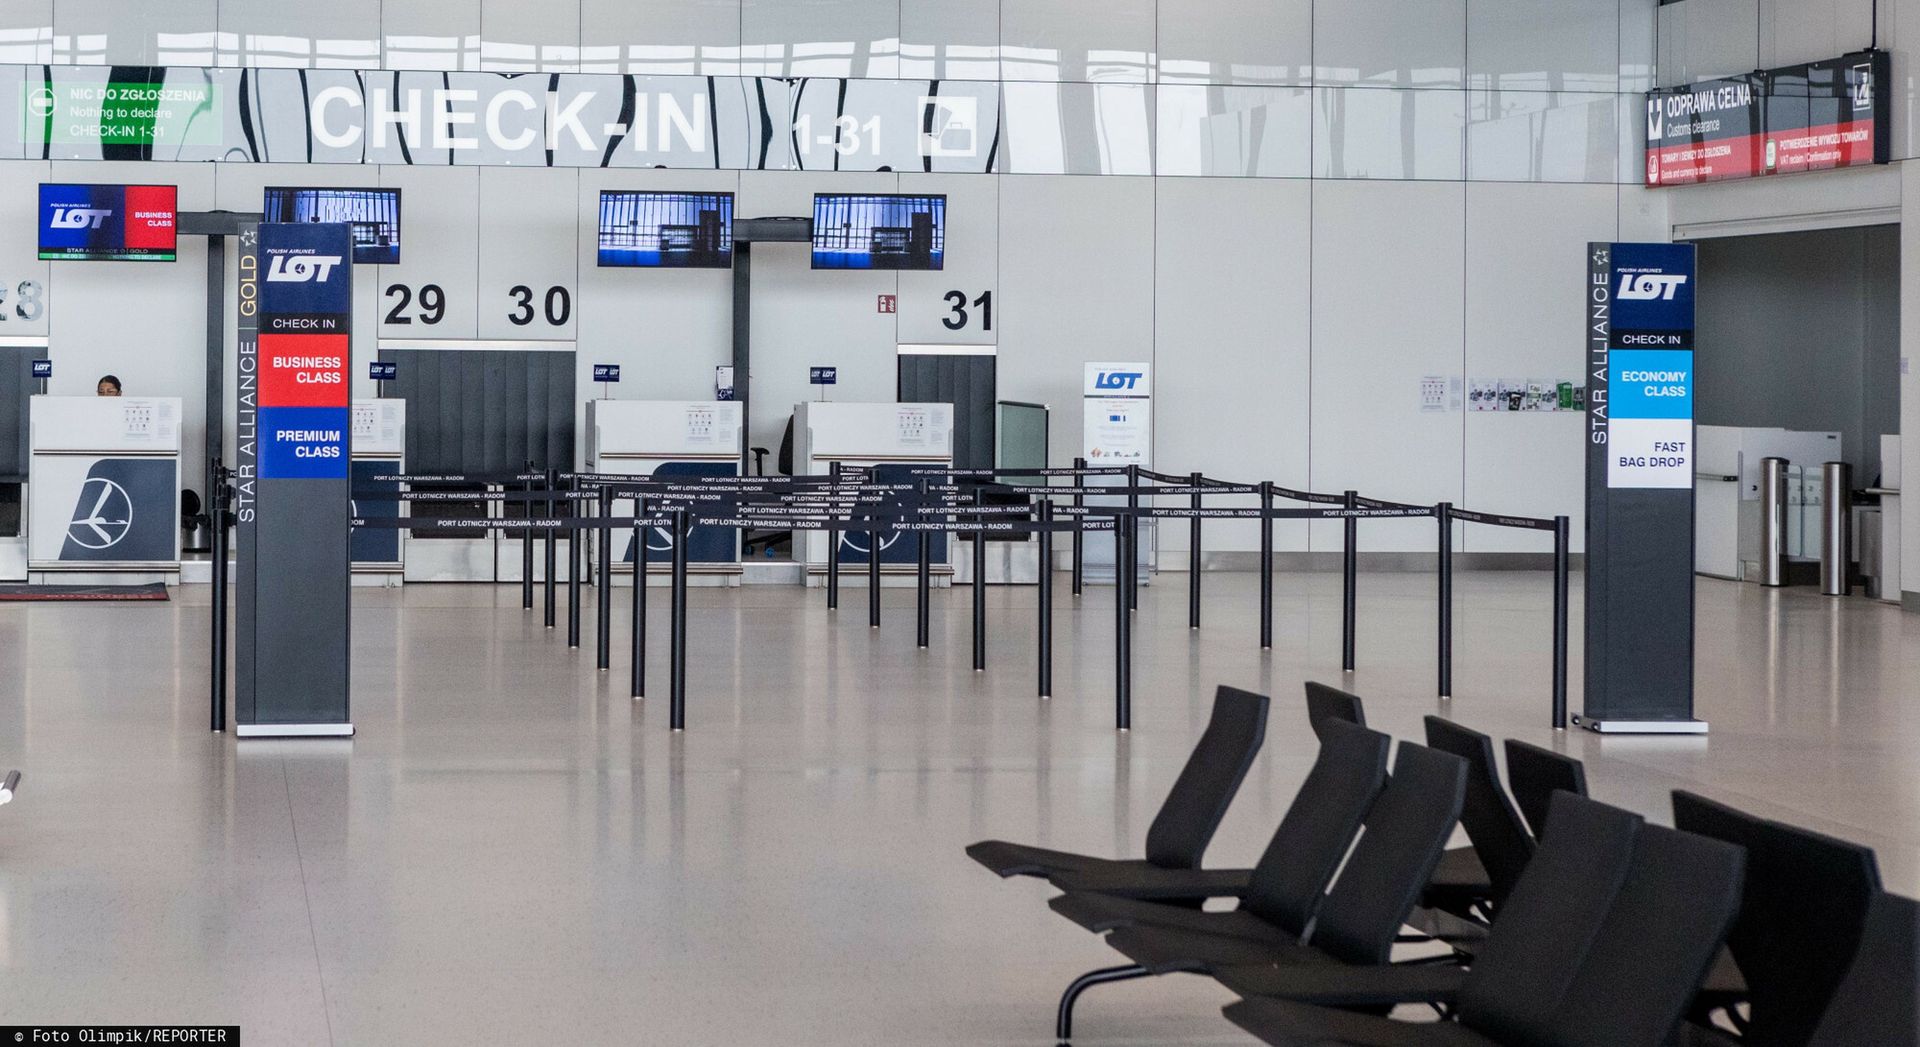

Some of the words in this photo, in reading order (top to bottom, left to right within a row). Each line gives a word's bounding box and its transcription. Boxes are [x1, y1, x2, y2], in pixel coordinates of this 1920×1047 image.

[70, 89, 93, 100] NIC
[96, 89, 116, 100] DO
[119, 89, 205, 101] ZGŁOSZENIA
[1667, 90, 1716, 118] ODPRAWA
[1718, 84, 1752, 109] CELNA
[70, 106, 114, 119] Nothing
[117, 107, 128, 118] to
[130, 107, 172, 118] declare
[310, 86, 705, 152] CHECK-IN
[792, 114, 881, 156] 1-31
[70, 125, 135, 137] CHECK-IN
[139, 125, 164, 137] 1-31
[1667, 123, 1692, 138] Customs
[1692, 119, 1720, 134] clearance
[50, 208, 112, 229] LOT
[266, 255, 342, 282] LOT
[240, 255, 257, 316] GOLD
[1616, 274, 1688, 300] LOT
[0, 280, 43, 321] 8
[384, 284, 446, 325] 29
[508, 285, 571, 326] 30
[941, 290, 992, 331] 31
[272, 319, 319, 329] CHECK
[323, 319, 336, 329] IN
[1593, 273, 1608, 382] ALLIANCE
[1622, 335, 1665, 344] CHECK
[1669, 335, 1681, 344] IN
[273, 356, 341, 369] BUSINESS
[296, 372, 341, 384] CLASS
[1095, 372, 1143, 389] LOT
[1621, 371, 1687, 382] ECONOMY
[239, 341, 256, 456] ALLIANCE
[1644, 386, 1686, 397] CLASS
[1592, 389, 1608, 444] STAR
[276, 430, 340, 442] PREMIUM
[295, 446, 340, 458] CLASS
[1654, 442, 1686, 452] FAST
[1619, 457, 1646, 467] BAG
[1650, 457, 1685, 467] DROP
[239, 464, 255, 523] STAR
[700, 518, 718, 526] PORT
[719, 519, 751, 527] LOTNICZY
